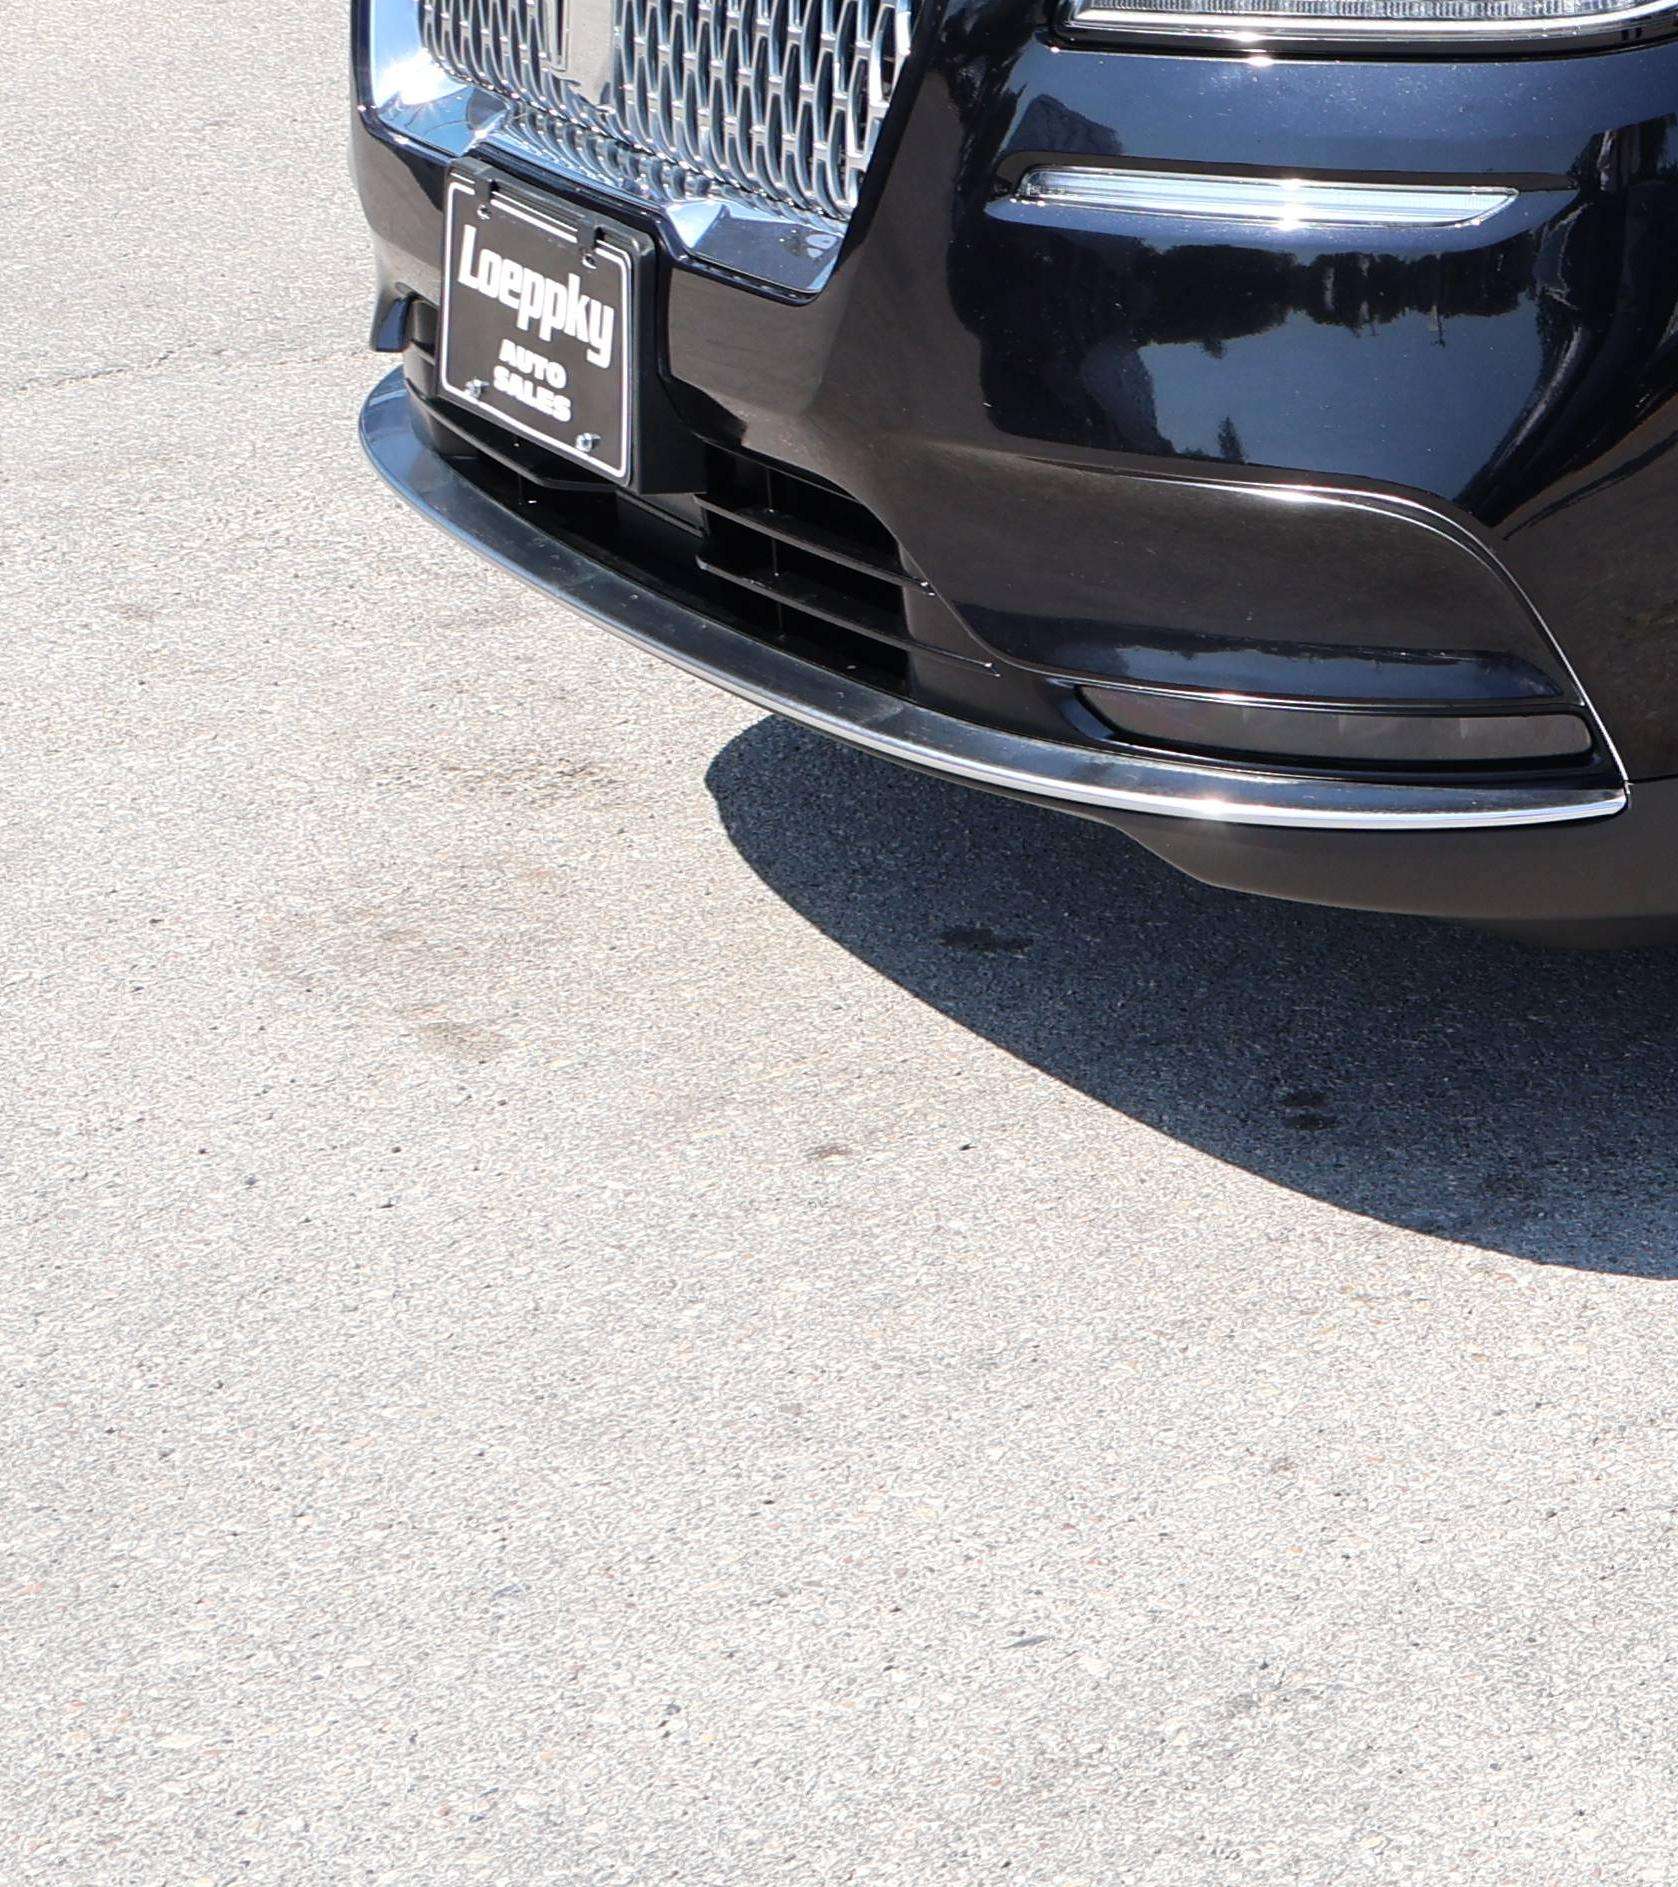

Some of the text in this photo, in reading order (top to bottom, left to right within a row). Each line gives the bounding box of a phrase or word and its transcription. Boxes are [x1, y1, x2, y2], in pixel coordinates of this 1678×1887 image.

[457, 223, 615, 369] Loeppky
[499, 339, 567, 389] AUTO
[493, 365, 572, 422] SALES
